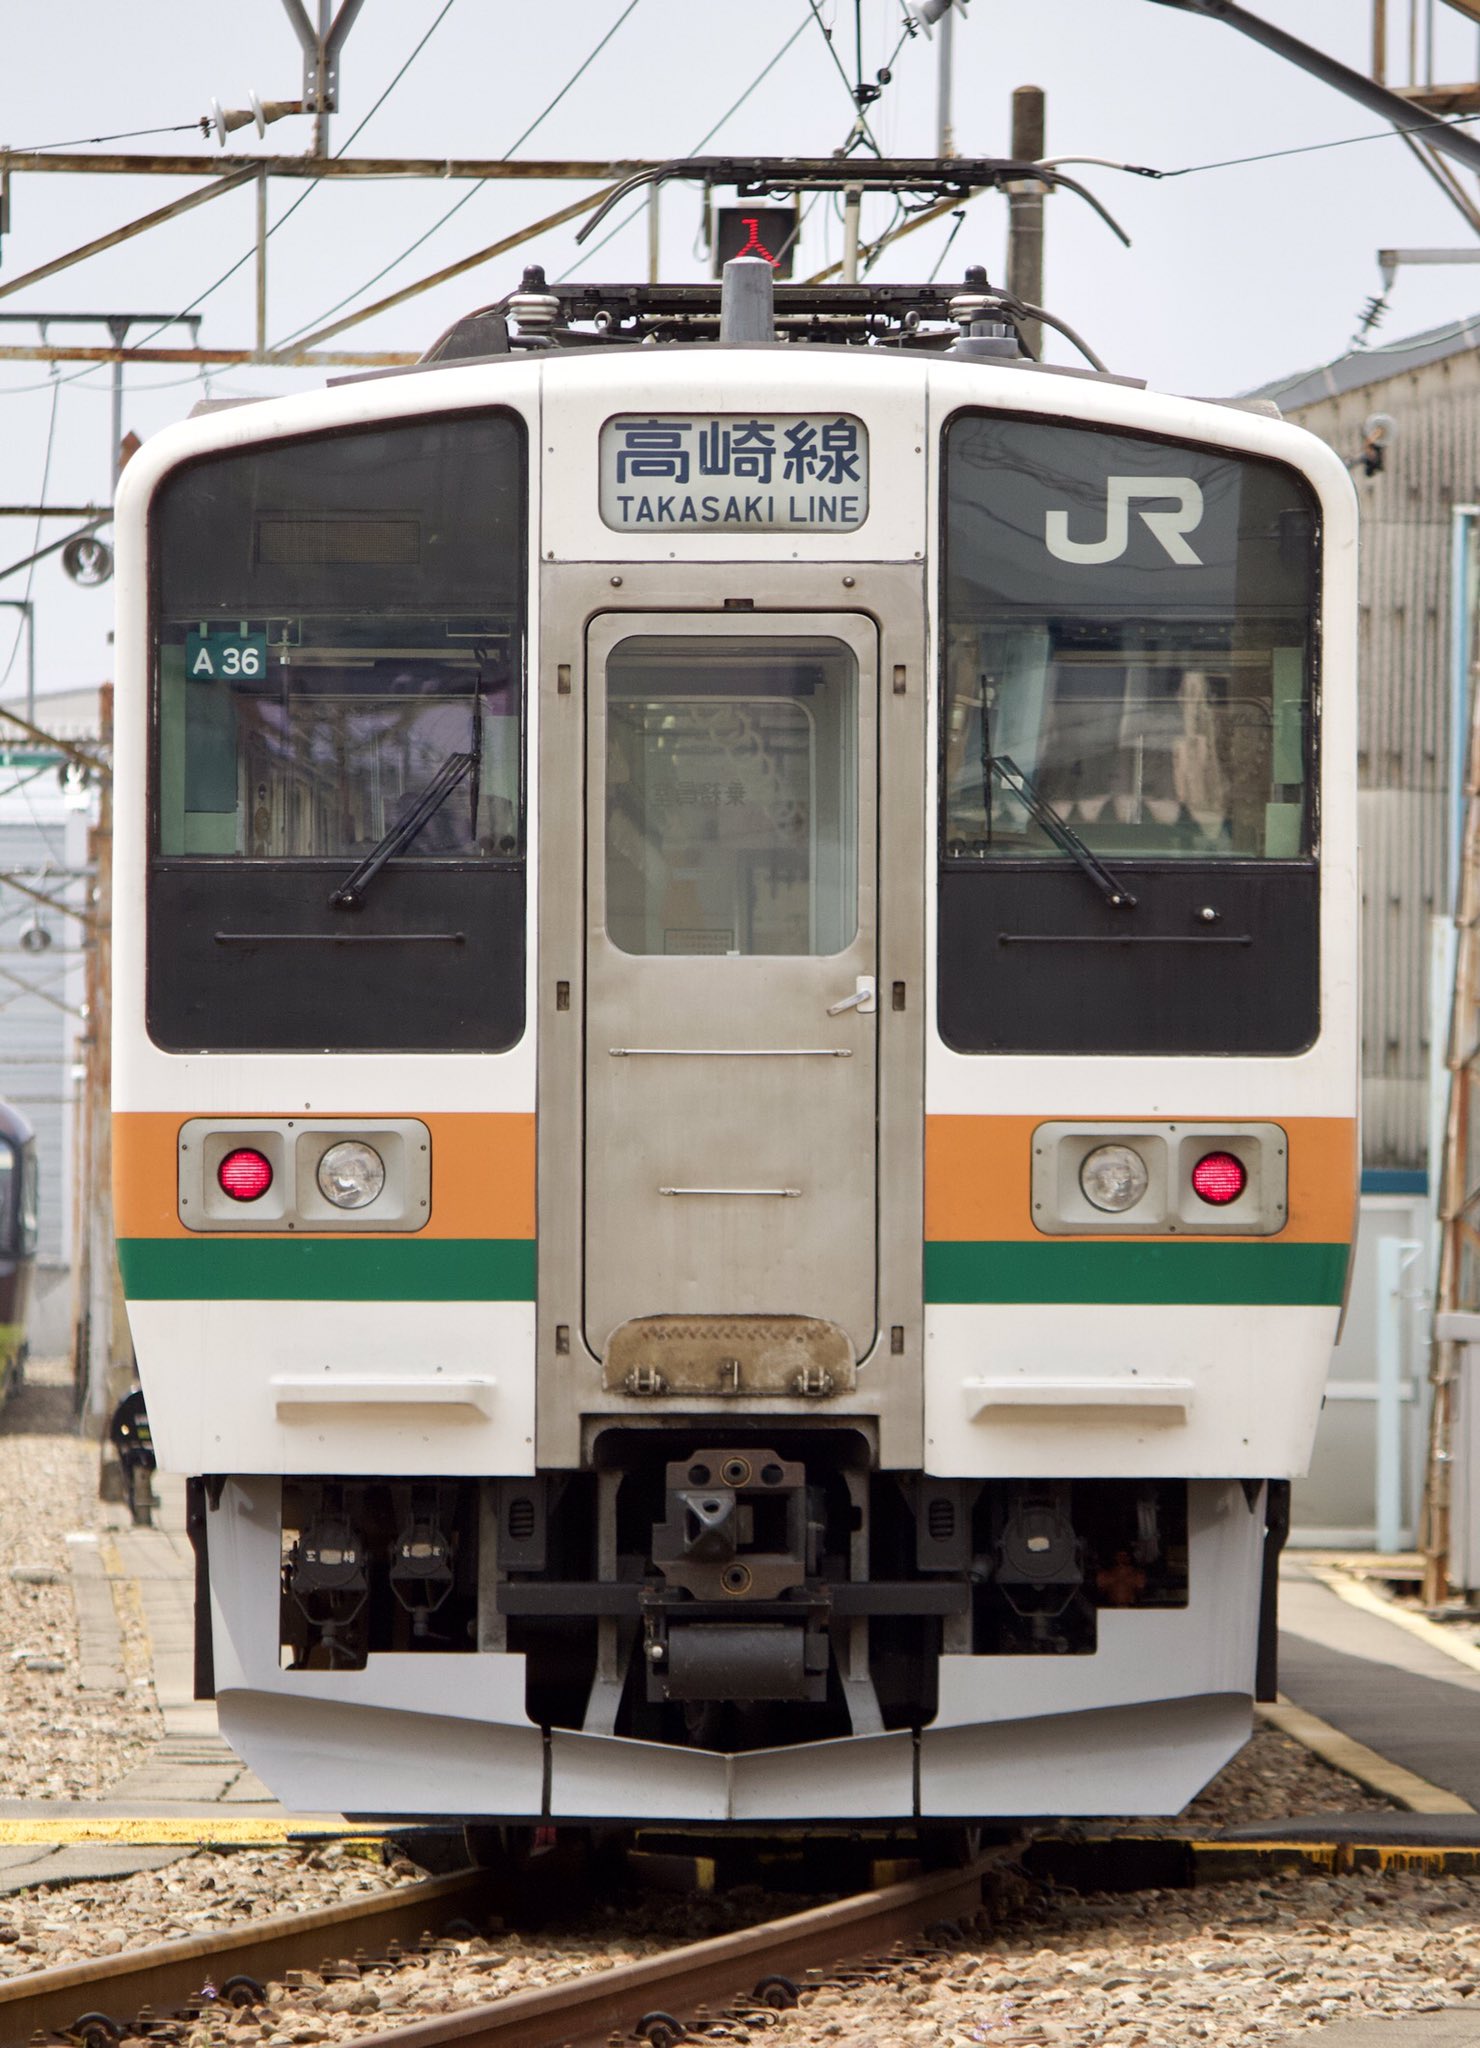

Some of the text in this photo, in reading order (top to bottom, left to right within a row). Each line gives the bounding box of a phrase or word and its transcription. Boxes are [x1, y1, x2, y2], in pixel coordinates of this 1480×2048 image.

[615, 418, 861, 484] 高崎線
[616, 496, 859, 522] TAKASAKI LINE
[1045, 476, 1204, 564] JR
[192, 647, 259, 675] A 36
